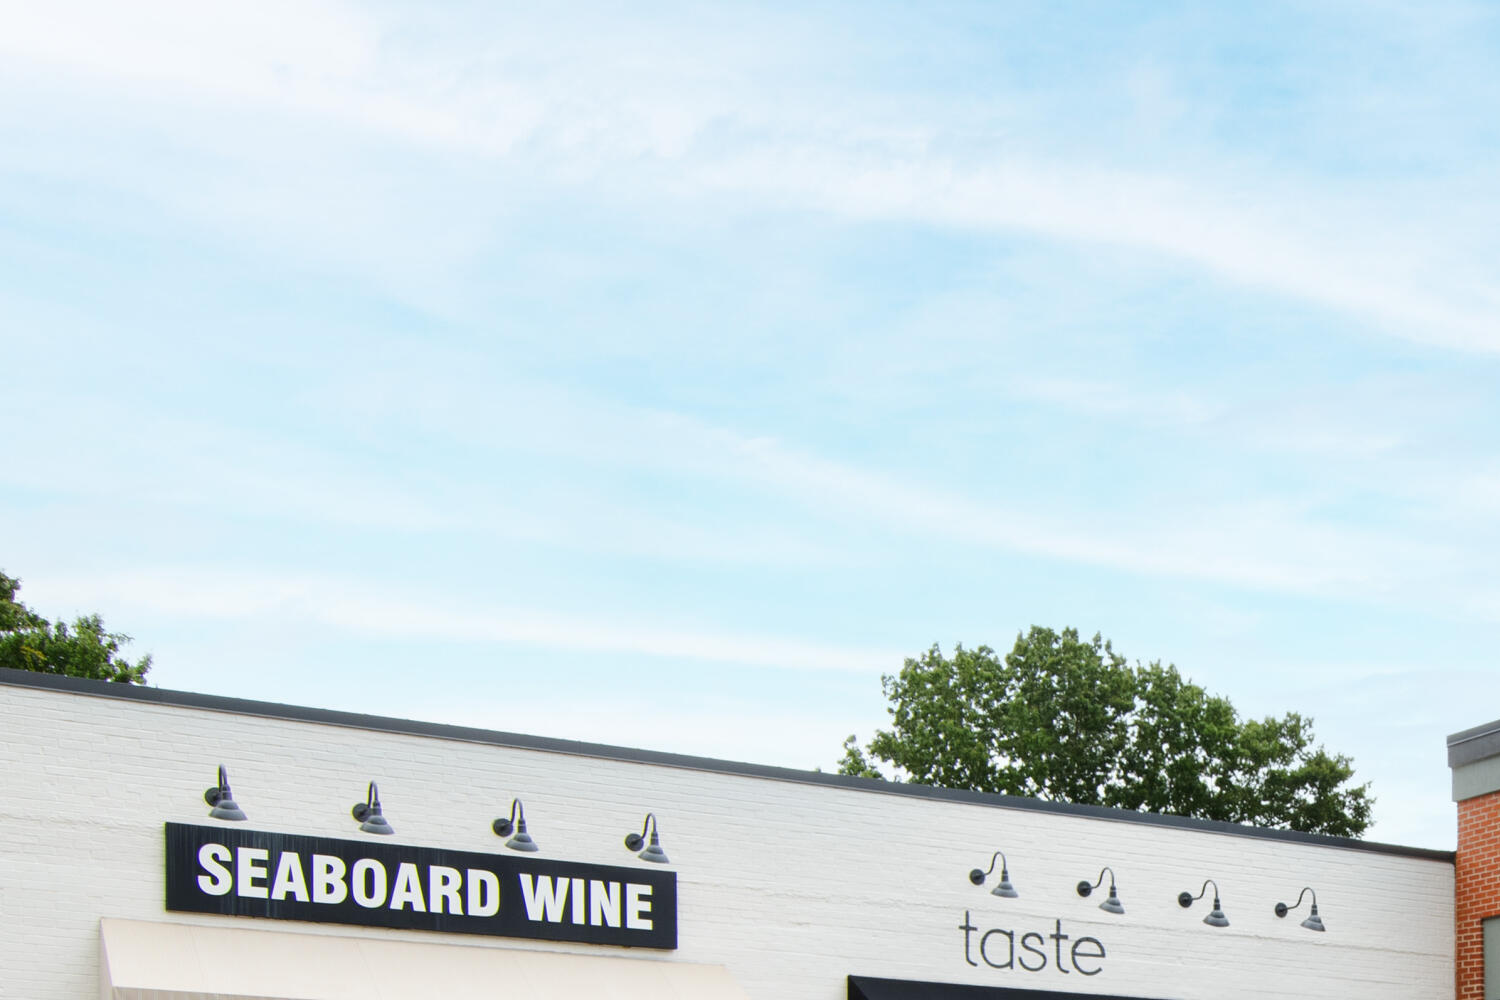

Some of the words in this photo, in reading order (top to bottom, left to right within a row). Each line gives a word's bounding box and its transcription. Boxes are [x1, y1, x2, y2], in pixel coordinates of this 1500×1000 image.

[197, 843, 500, 918] SEABOARD
[518, 872, 654, 931] WINE
[958, 910, 1106, 976] taste
